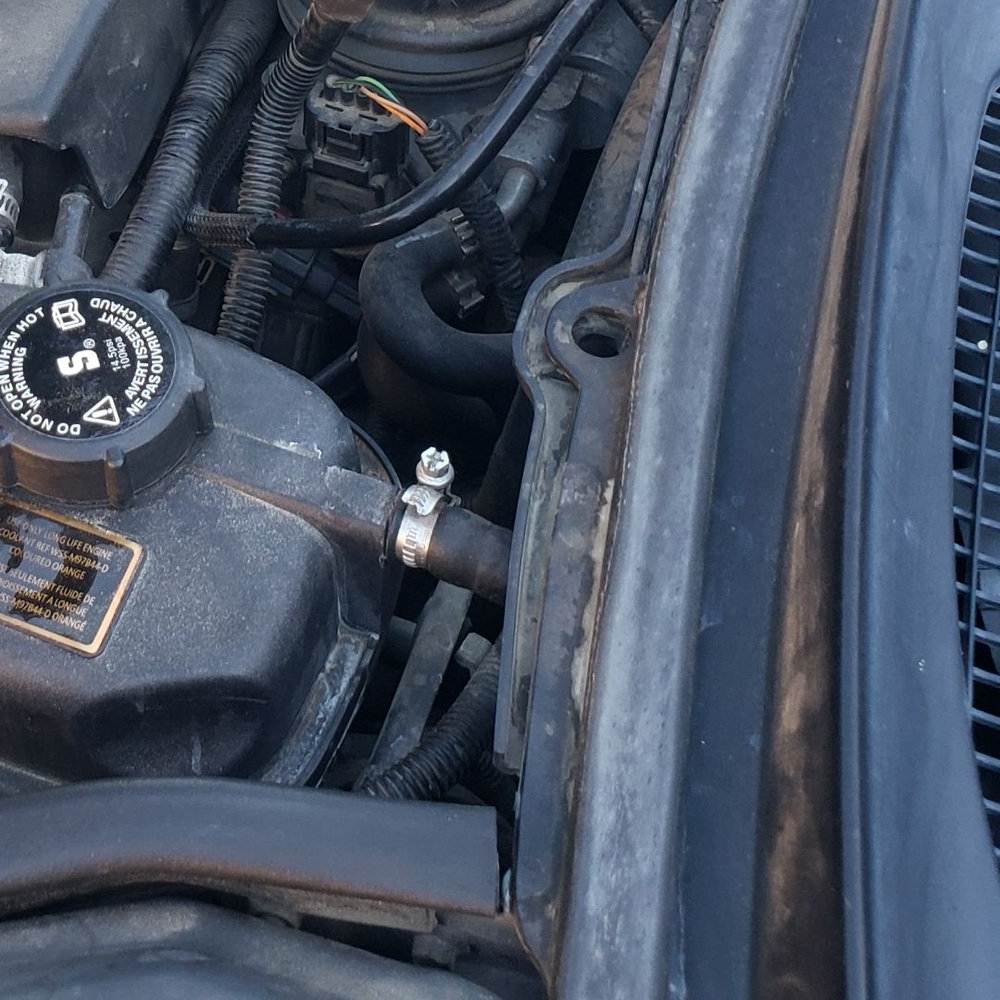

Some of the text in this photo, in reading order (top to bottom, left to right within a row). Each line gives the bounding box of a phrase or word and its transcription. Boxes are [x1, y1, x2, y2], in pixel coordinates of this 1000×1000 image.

[16, 307, 45, 332] HOT
[90, 297, 163, 416] NE PAS OUVRIR A CHAUD
[105, 338, 121, 372] 14.5psi
[115, 336, 131, 370] 100kpa
[11, 347, 41, 410] WARNING
[21, 408, 54, 431] NOT
[57, 423, 81, 435] DO
[35, 540, 50, 552] REF
[43, 528, 66, 543] LONG
[66, 536, 82, 549] LIFE
[82, 542, 113, 559] ENGINE
[51, 561, 86, 579] ORANGE
[8, 567, 56, 591] SEULEMENT
[55, 584, 83, 601] FLUIDE
[82, 593, 95, 605] DE
[53, 597, 88, 617] LONGUE
